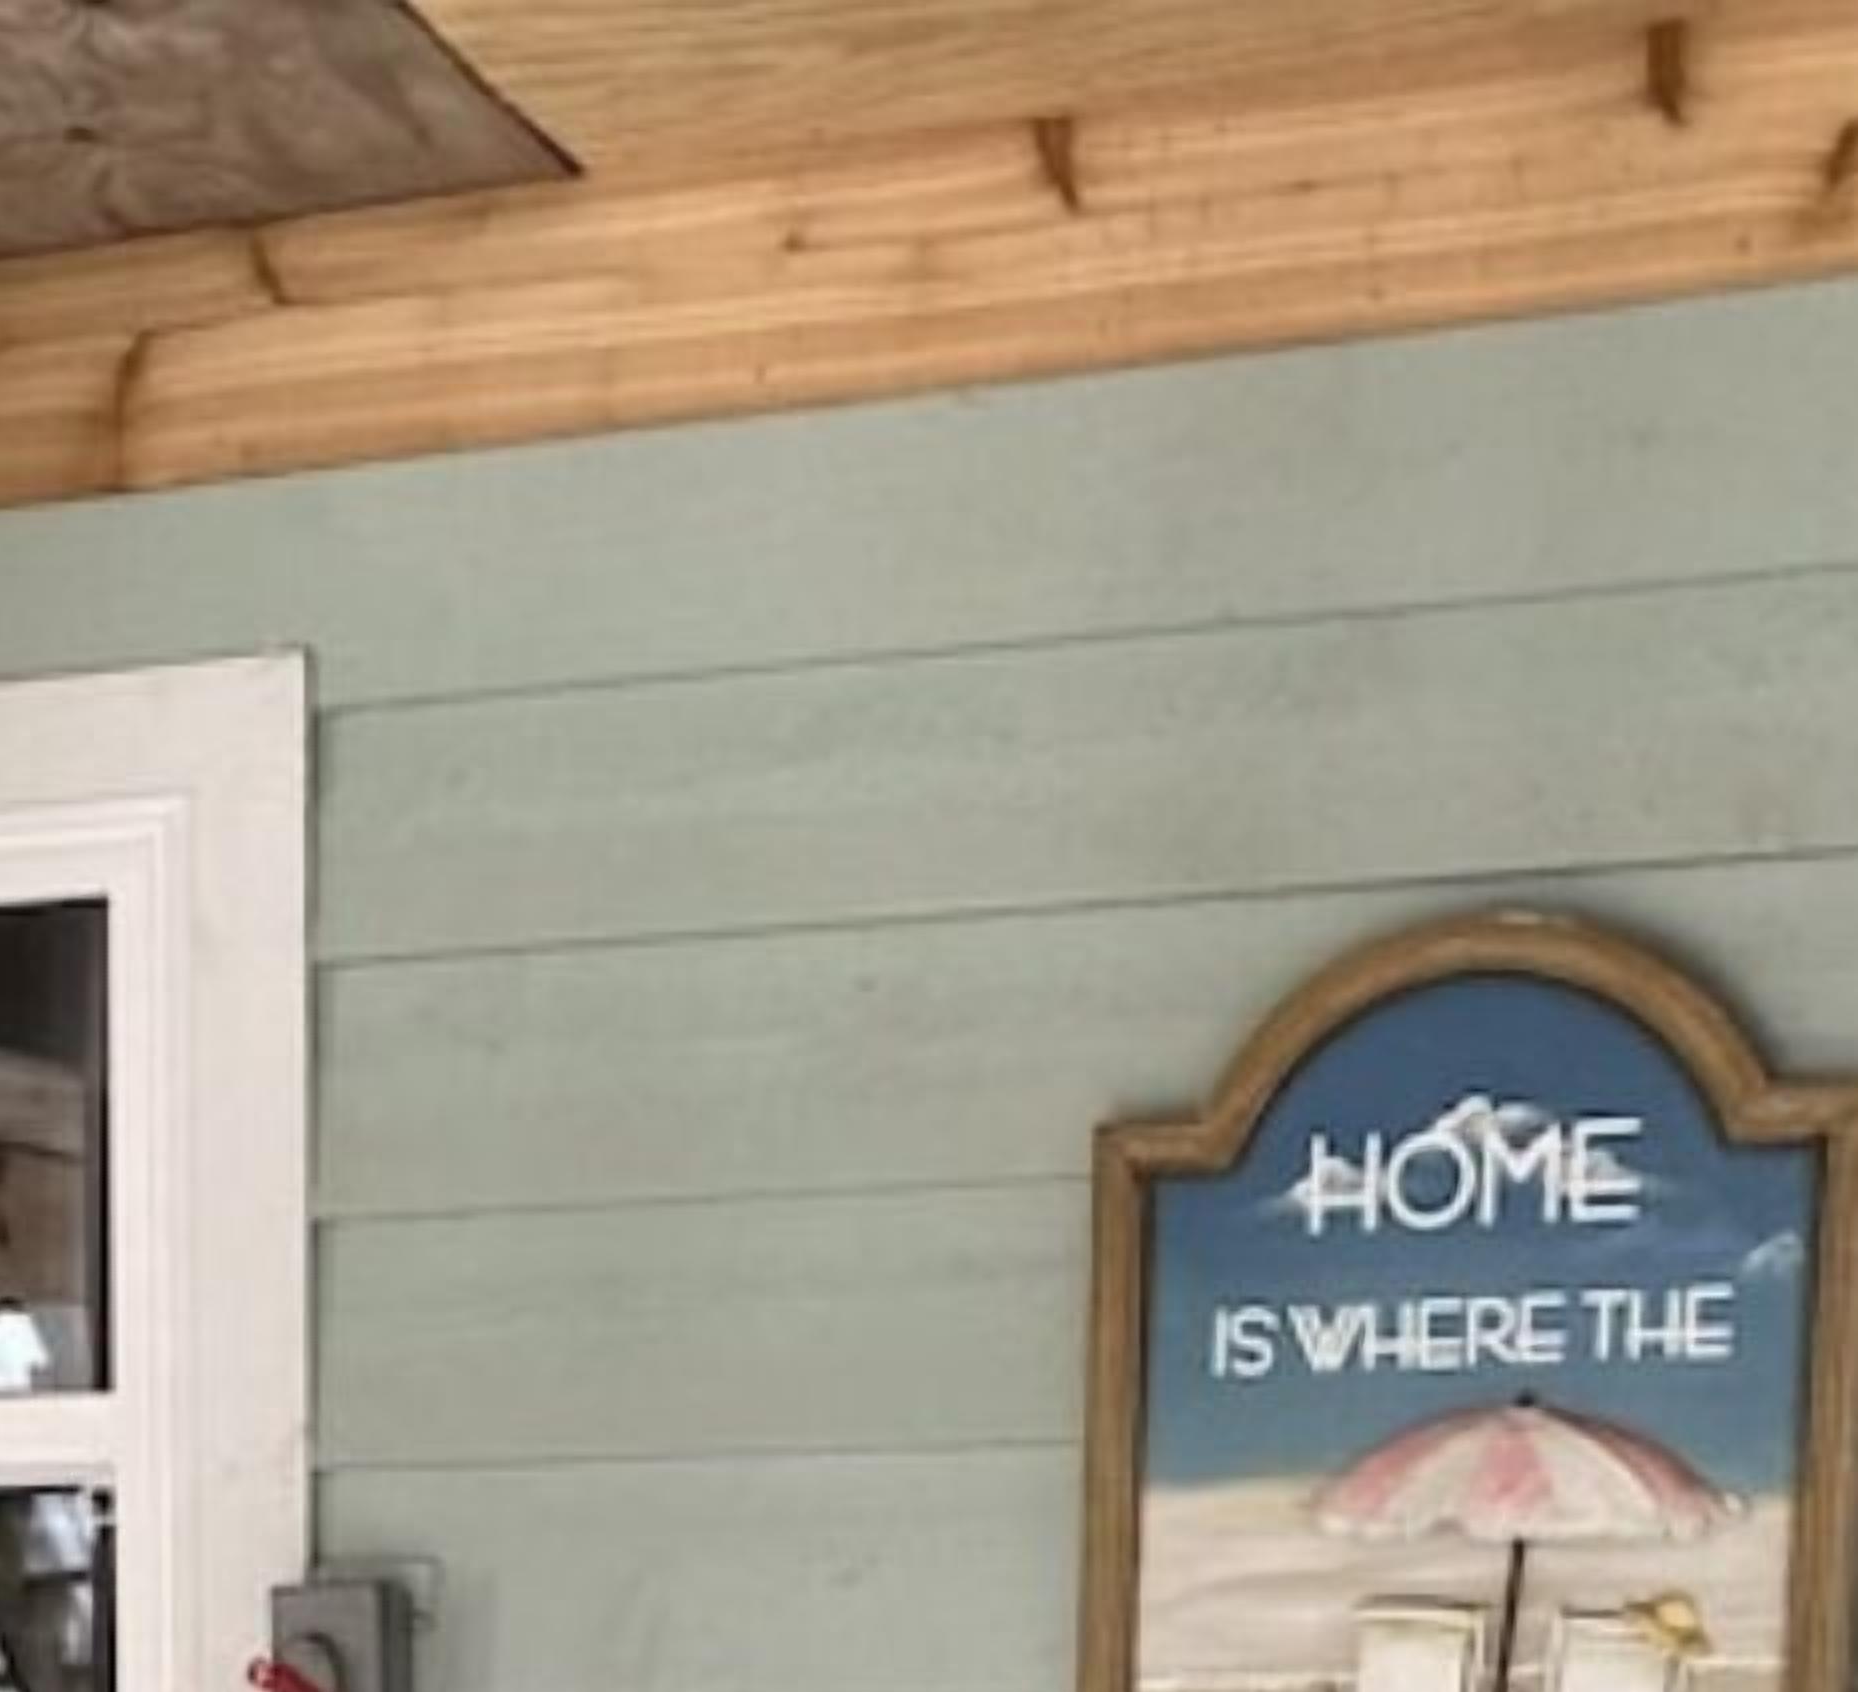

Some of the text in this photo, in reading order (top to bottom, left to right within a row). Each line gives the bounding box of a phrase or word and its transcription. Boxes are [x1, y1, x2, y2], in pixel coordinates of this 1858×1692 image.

[1307, 1117, 1642, 1236] HOME
[1210, 1282, 1735, 1378] IS WHERE THE
